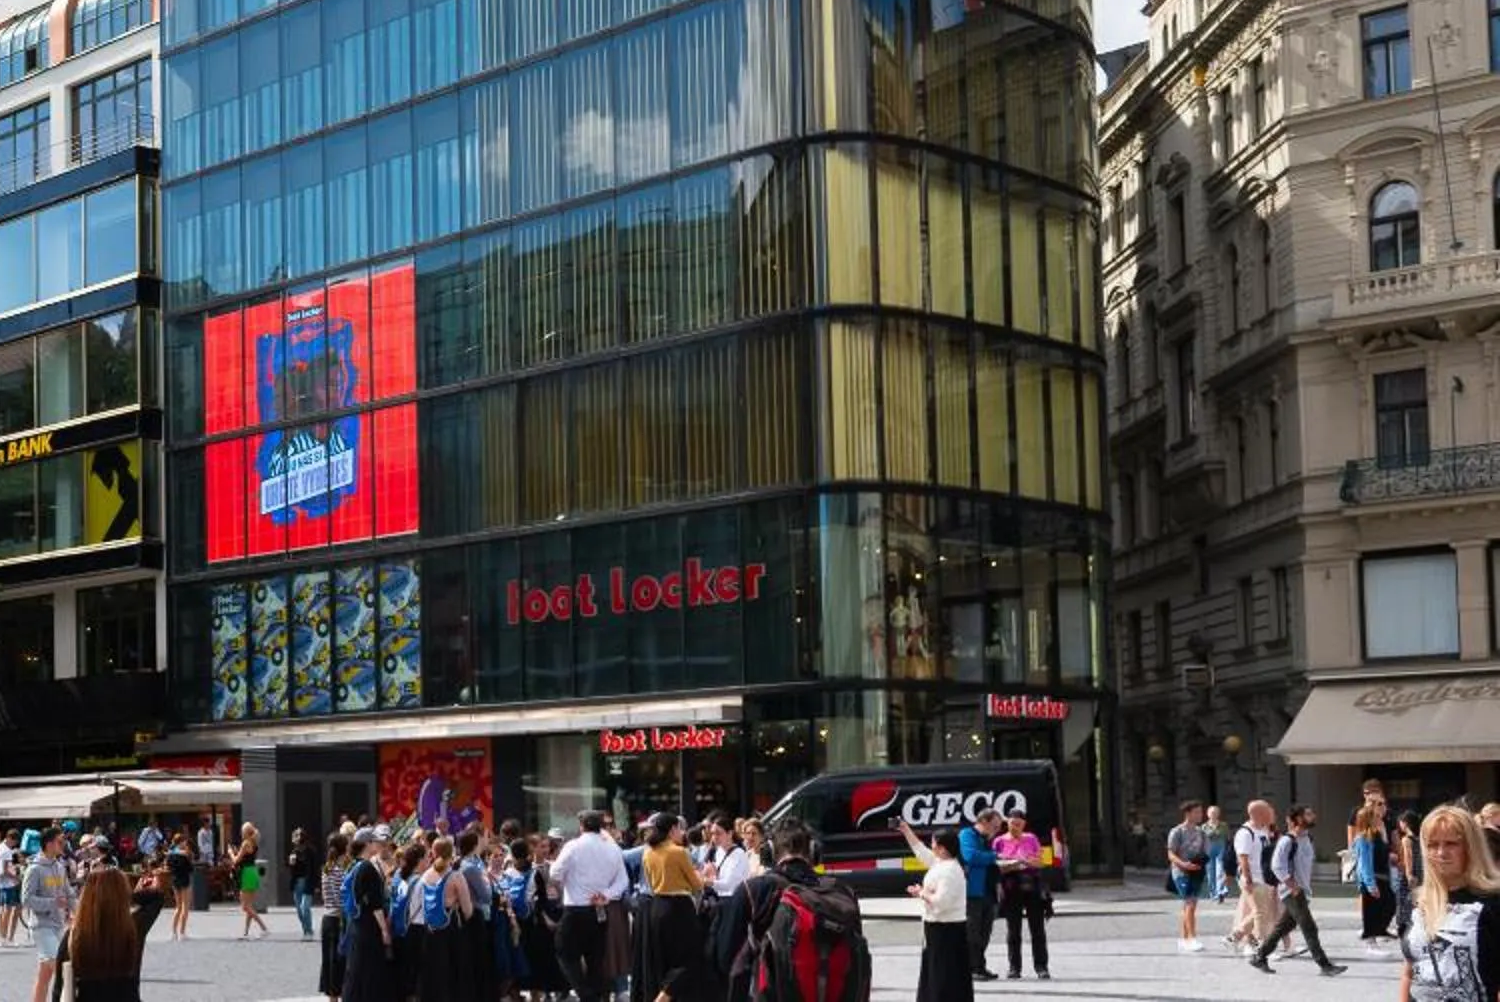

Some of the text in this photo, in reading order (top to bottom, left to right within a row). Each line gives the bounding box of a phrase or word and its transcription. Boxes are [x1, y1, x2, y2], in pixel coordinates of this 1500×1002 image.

[7, 432, 53, 461] BANK
[609, 556, 766, 615] Locker
[600, 724, 725, 754] Foot Locker
[902, 789, 1028, 827] GECO
